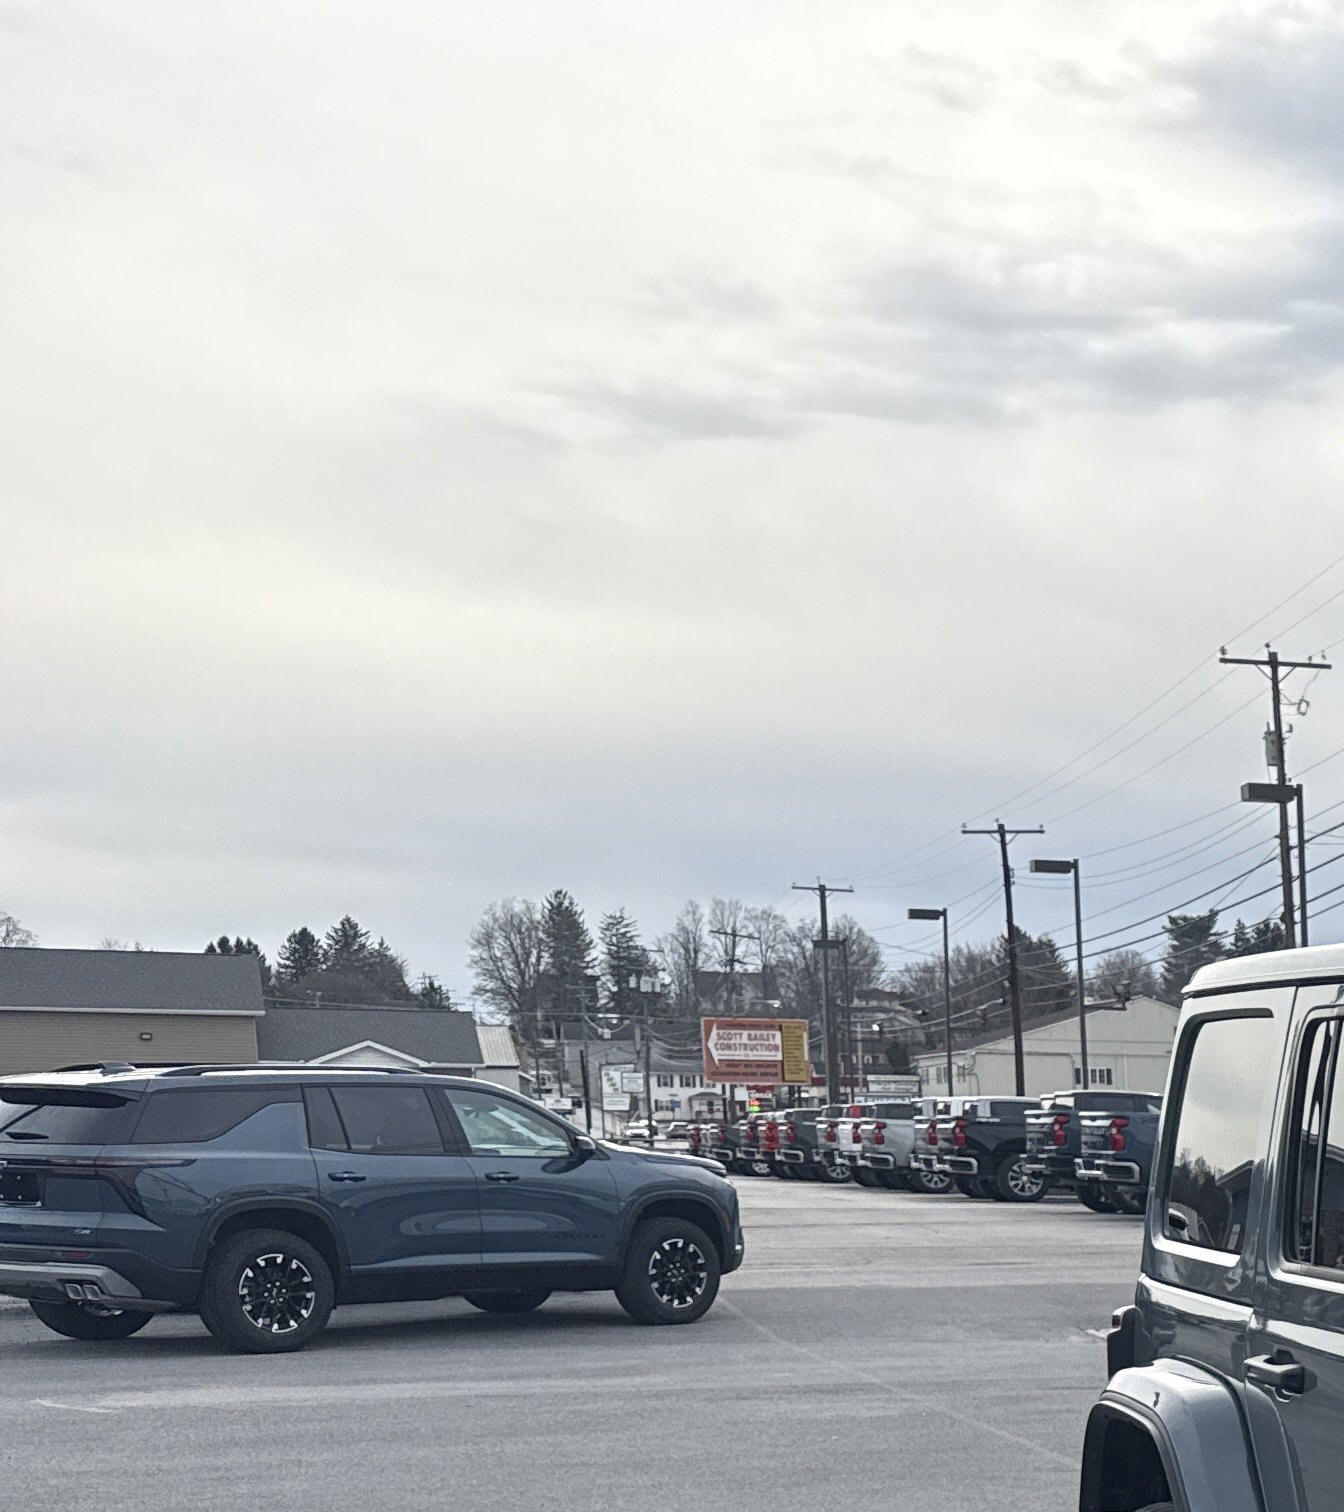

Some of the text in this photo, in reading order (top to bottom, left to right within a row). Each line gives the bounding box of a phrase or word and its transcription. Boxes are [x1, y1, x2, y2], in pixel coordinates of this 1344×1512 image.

[716, 1031, 777, 1042] SCOTT BAILEY
[714, 1042, 780, 1053] CONSTRUCTION
